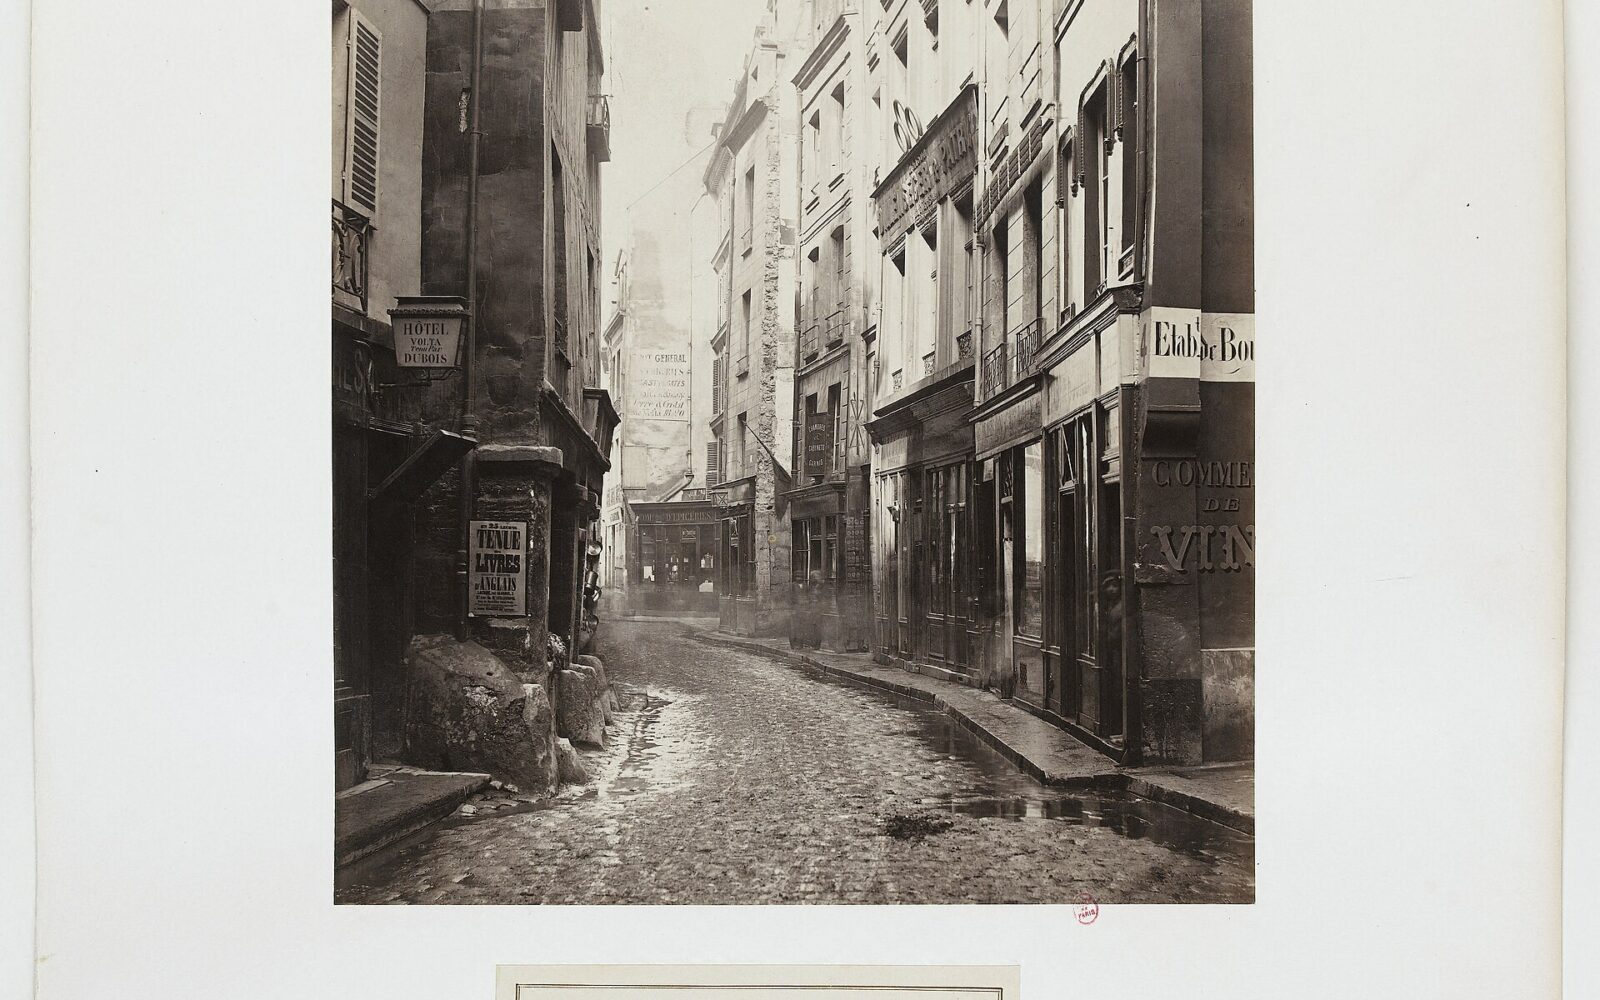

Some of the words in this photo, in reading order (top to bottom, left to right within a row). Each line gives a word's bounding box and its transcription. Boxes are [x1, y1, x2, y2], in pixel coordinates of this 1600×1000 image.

[404, 320, 449, 335] HÔTEL
[410, 338, 441, 346] VOLTA
[404, 353, 447, 364] DUBOIS
[1152, 460, 1254, 488] COMME
[1202, 498, 1240, 513] DE
[477, 530, 521, 550] TENUE
[475, 553, 521, 573] LIVRES
